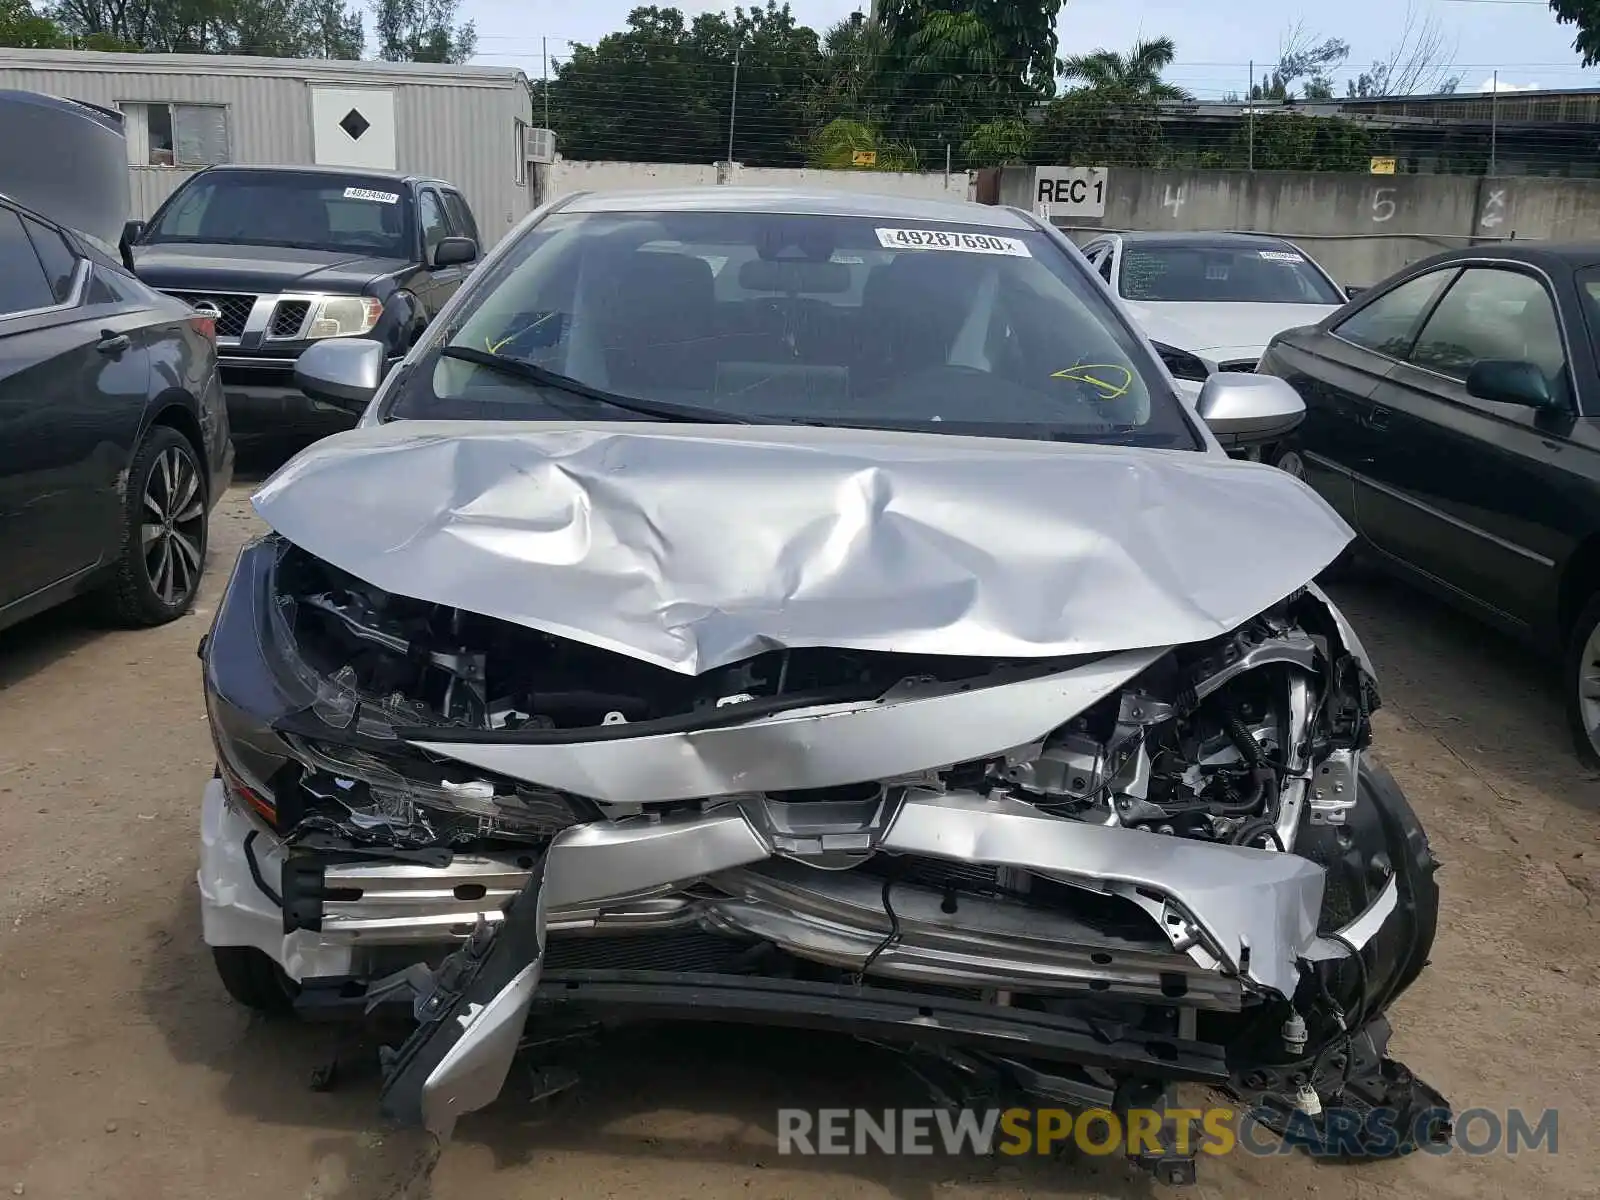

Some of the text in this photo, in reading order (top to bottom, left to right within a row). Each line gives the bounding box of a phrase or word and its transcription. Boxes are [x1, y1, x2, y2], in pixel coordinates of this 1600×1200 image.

[1038, 179, 1103, 203] REC 1
[1163, 183, 1185, 218] 4
[1372, 188, 1397, 222] 5
